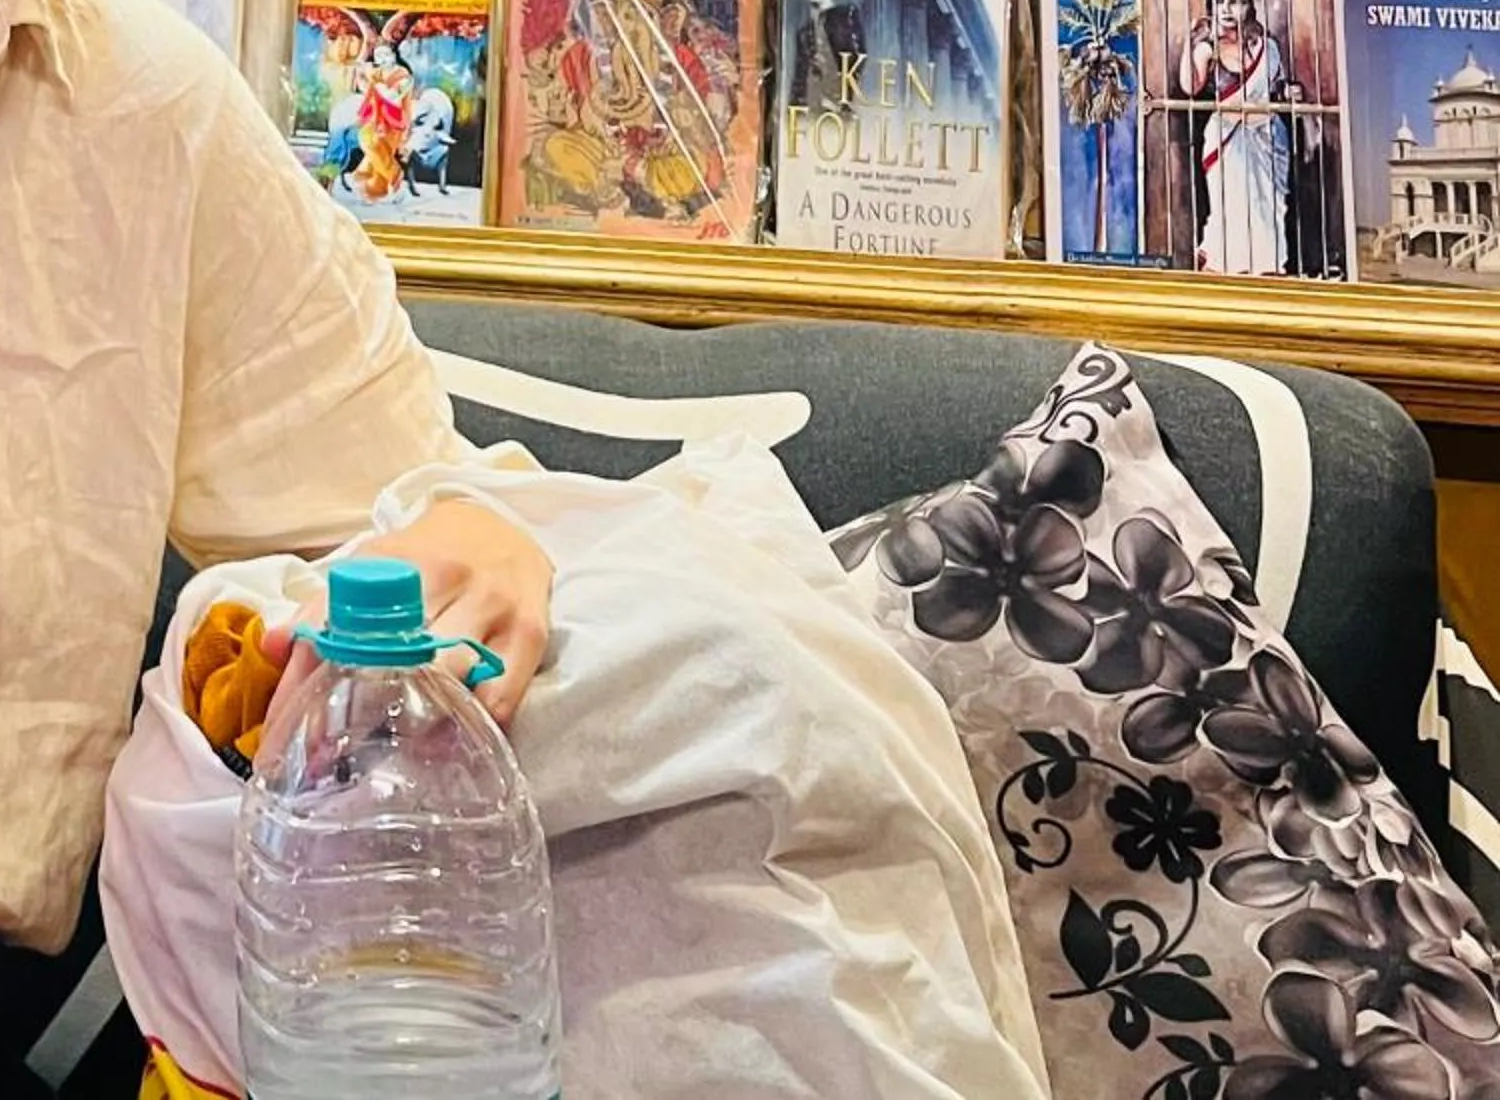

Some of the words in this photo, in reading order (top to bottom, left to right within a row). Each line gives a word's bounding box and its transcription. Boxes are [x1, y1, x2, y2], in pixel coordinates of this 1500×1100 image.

[1366, 5, 1431, 28] SWAMI
[838, 51, 937, 112] KEN
[786, 106, 990, 173] FOLLETT
[798, 189, 815, 219] A
[831, 191, 972, 230] DANGEROUS
